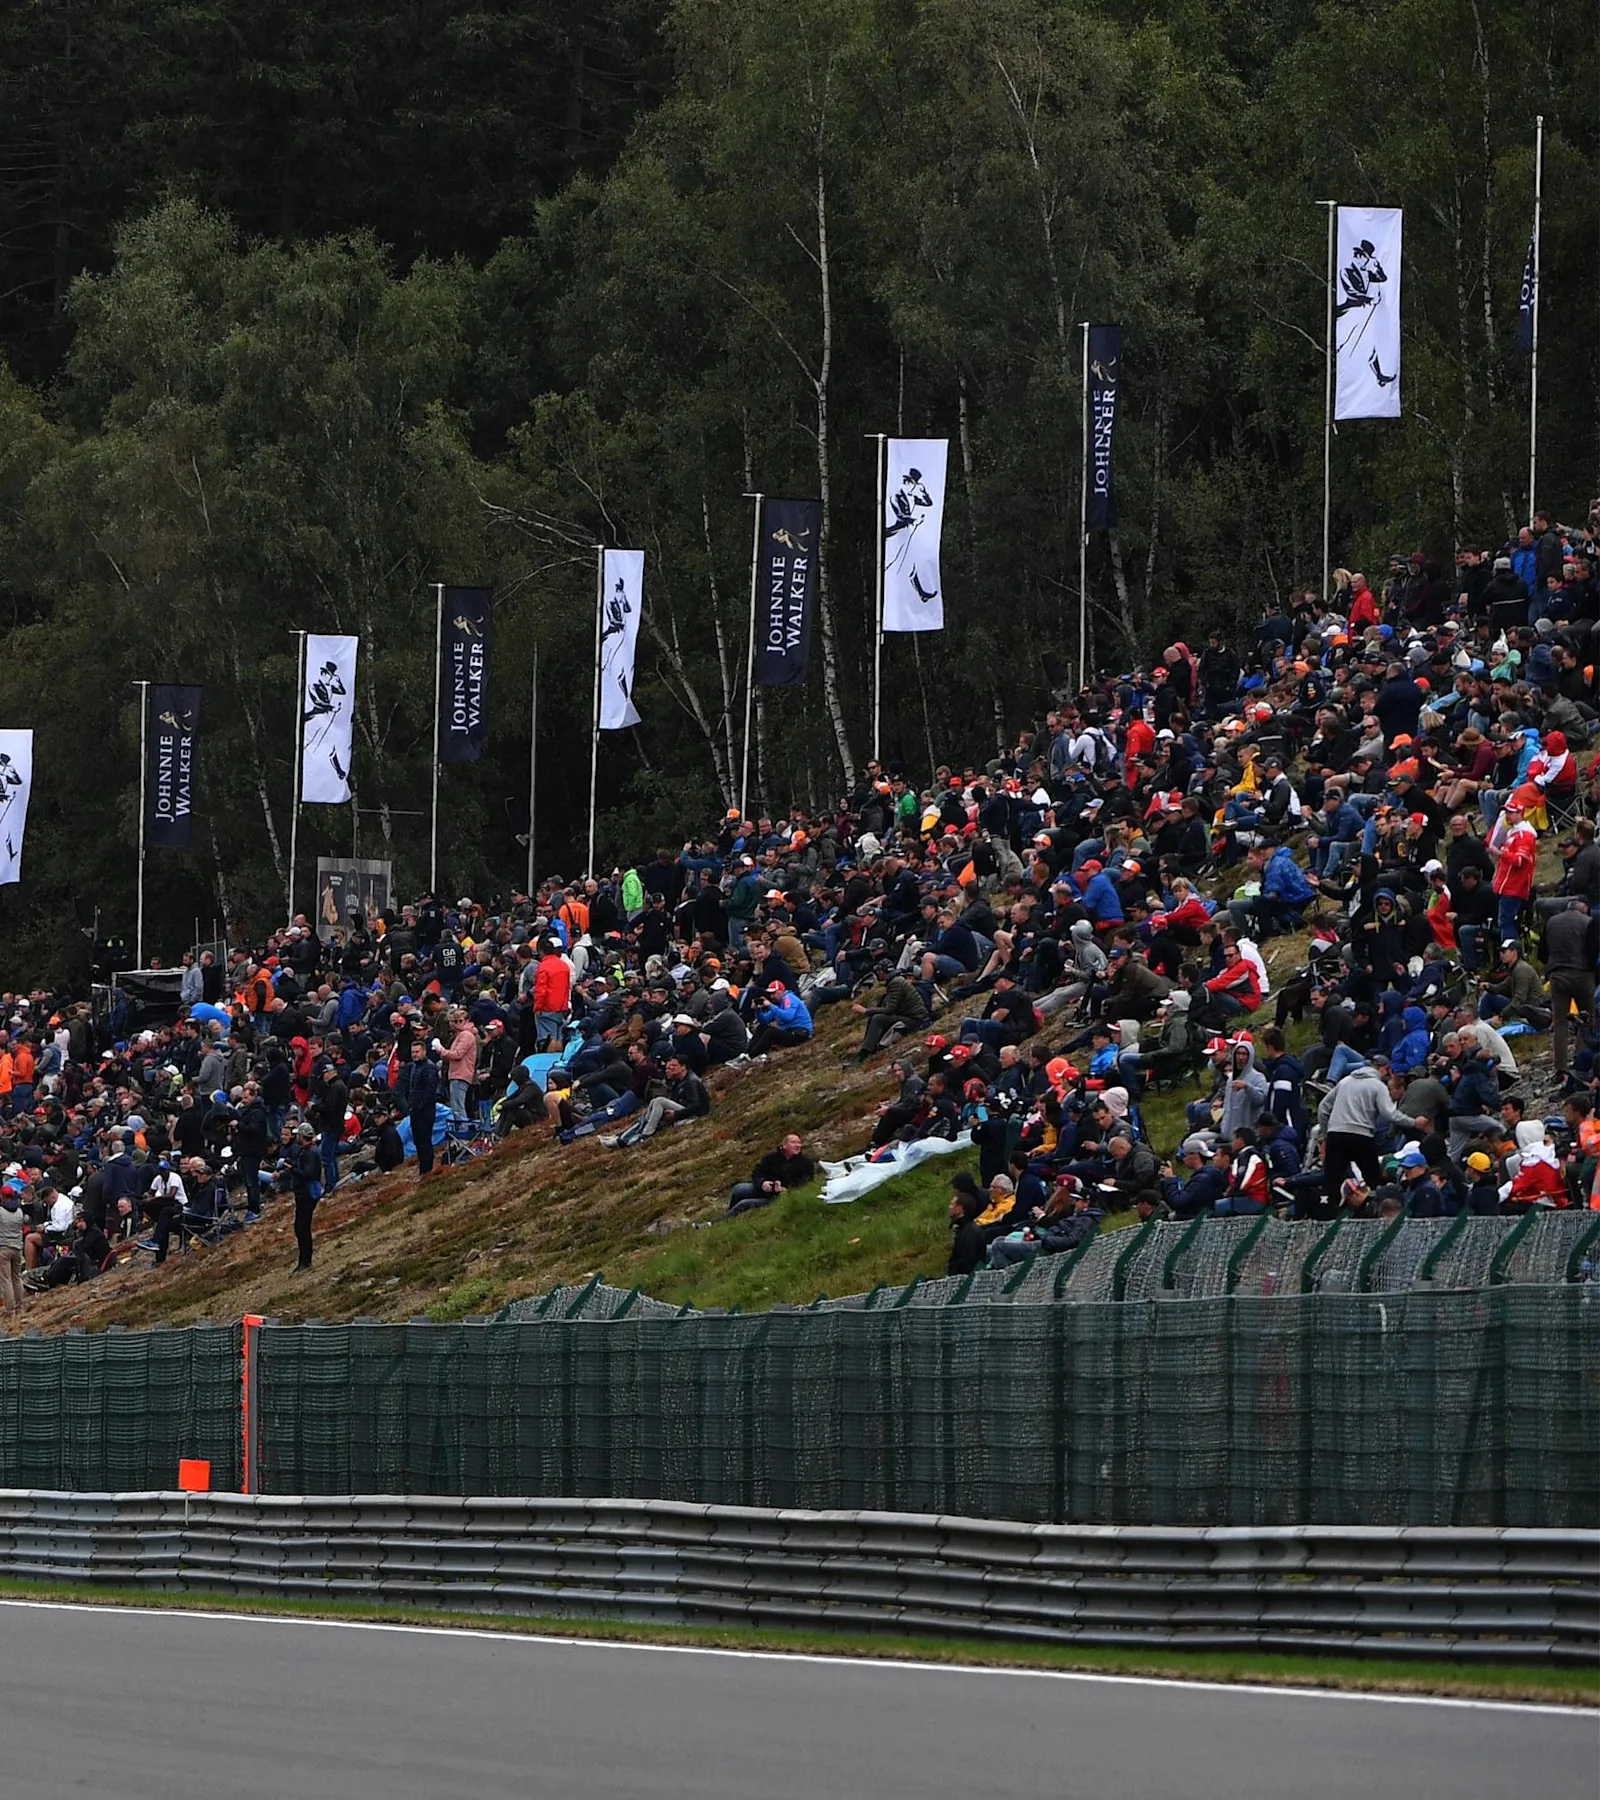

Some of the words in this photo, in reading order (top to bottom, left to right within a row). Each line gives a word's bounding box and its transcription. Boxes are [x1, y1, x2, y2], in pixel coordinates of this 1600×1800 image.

[1094, 389, 1108, 498] JOHNNIE
[766, 556, 787, 656] JOHNNIE
[786, 557, 809, 649] WALKER
[451, 642, 470, 735] JOHNNIE
[468, 643, 484, 727] WALKER
[155, 735, 175, 823] JOHNNIE
[175, 736, 192, 817] WALKER
[442, 948, 456, 956] GA
[443, 958, 456, 967] 02
